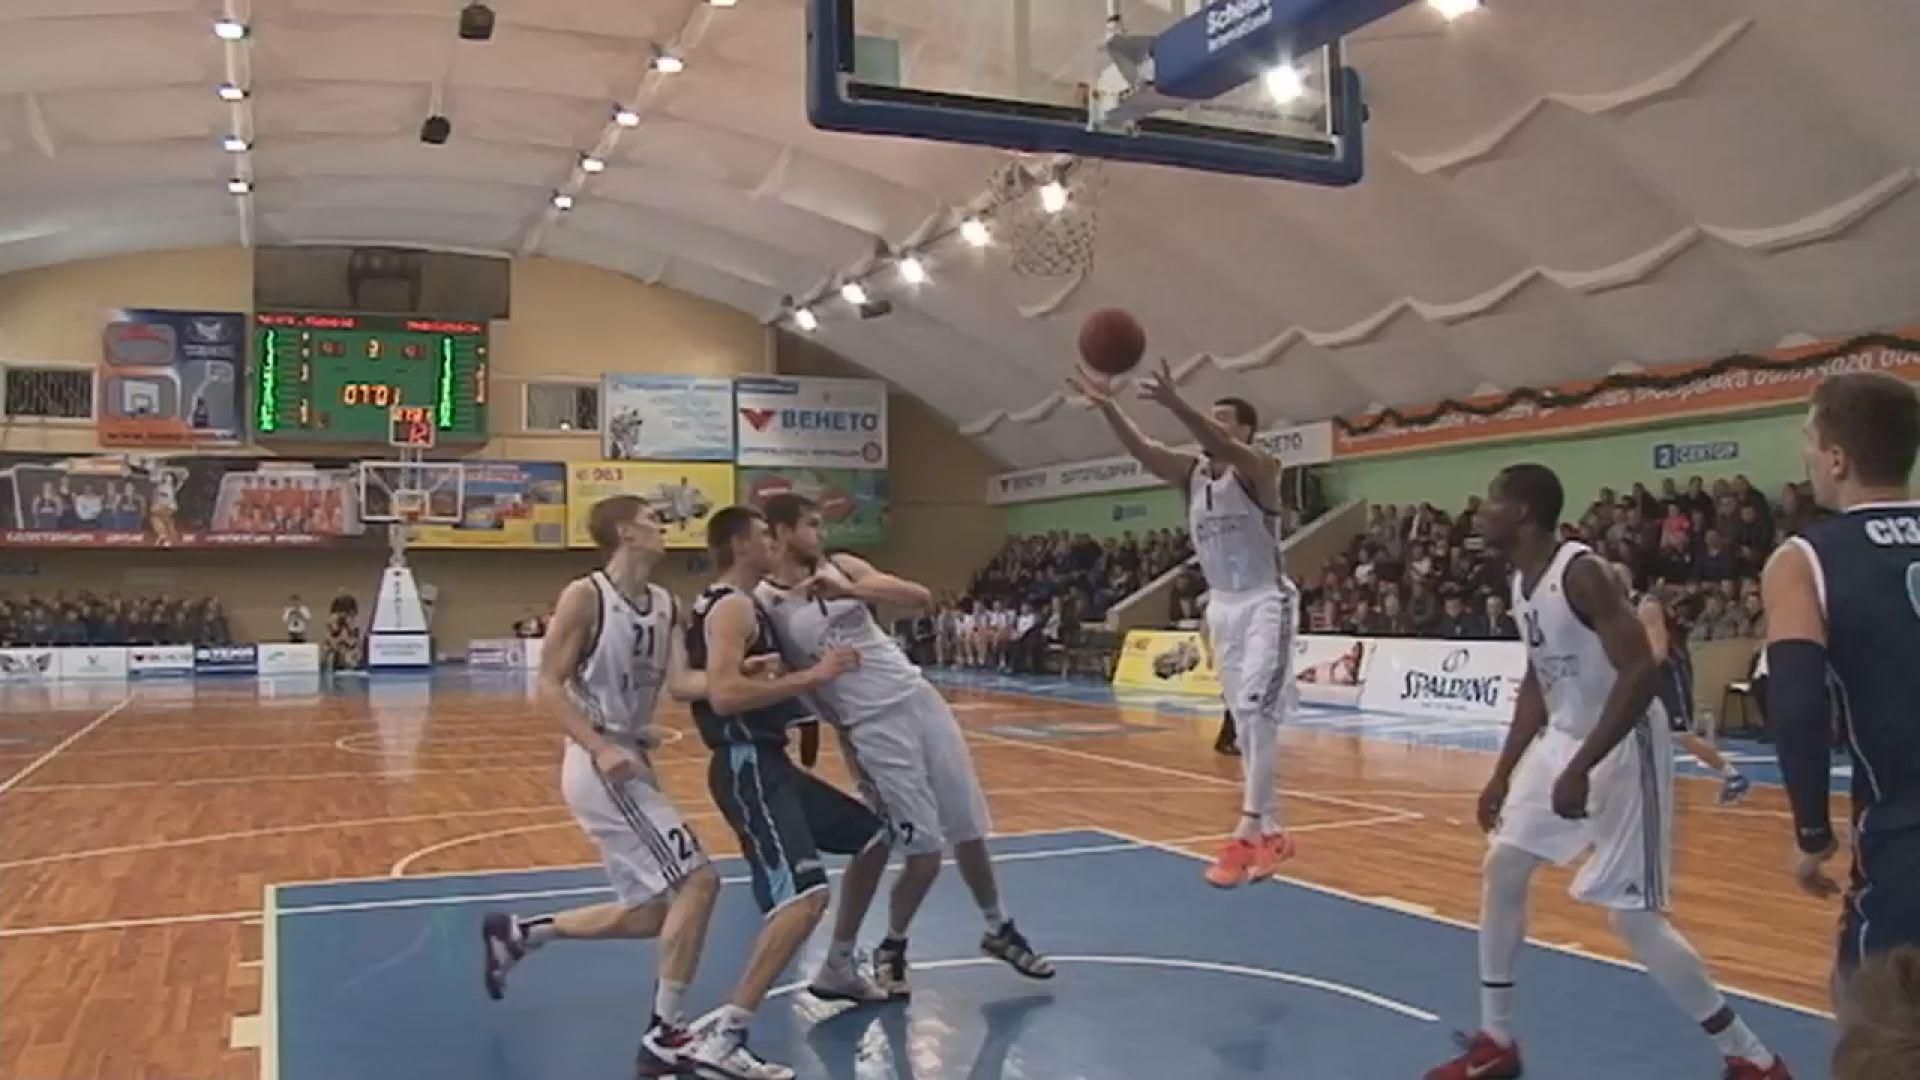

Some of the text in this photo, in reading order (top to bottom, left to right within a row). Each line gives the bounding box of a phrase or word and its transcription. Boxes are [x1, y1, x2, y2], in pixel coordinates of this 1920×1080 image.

[782, 407, 878, 432] ВЕНЕТО
[632, 623, 655, 657] 21
[1400, 670, 1502, 707] SPALDING
